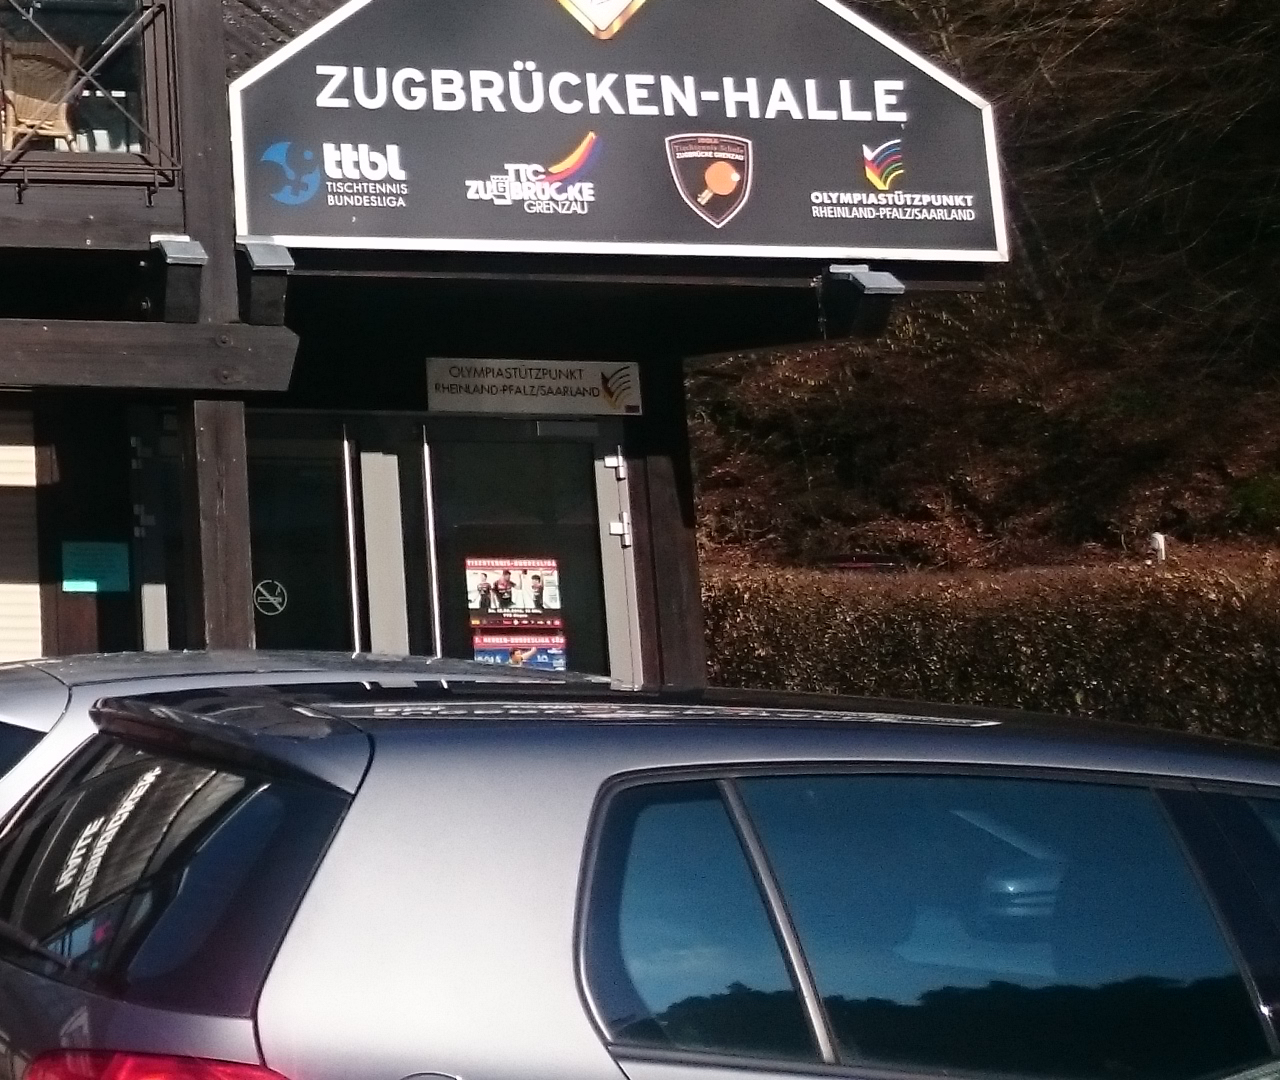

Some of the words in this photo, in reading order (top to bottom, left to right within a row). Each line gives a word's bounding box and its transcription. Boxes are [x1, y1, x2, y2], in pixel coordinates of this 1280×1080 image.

[315, 61, 908, 122] ZUGBRÜCKEN-HALLE
[323, 143, 407, 181] ttbl
[504, 163, 546, 182] TTC
[326, 182, 408, 195] TISCHTENNIS
[327, 194, 406, 208] BUNDESLIGA
[810, 191, 974, 207] OLYMPIASTÜTZPUNKT
[523, 201, 589, 215] GRENZAU
[811, 205, 976, 221] RHEINLAND-PFALZ/SAARLAND
[448, 365, 584, 381] OLYMPIASTÜTZPUNKT
[434, 383, 601, 398] RHEINLAND-PFALZ/SAARLAND
